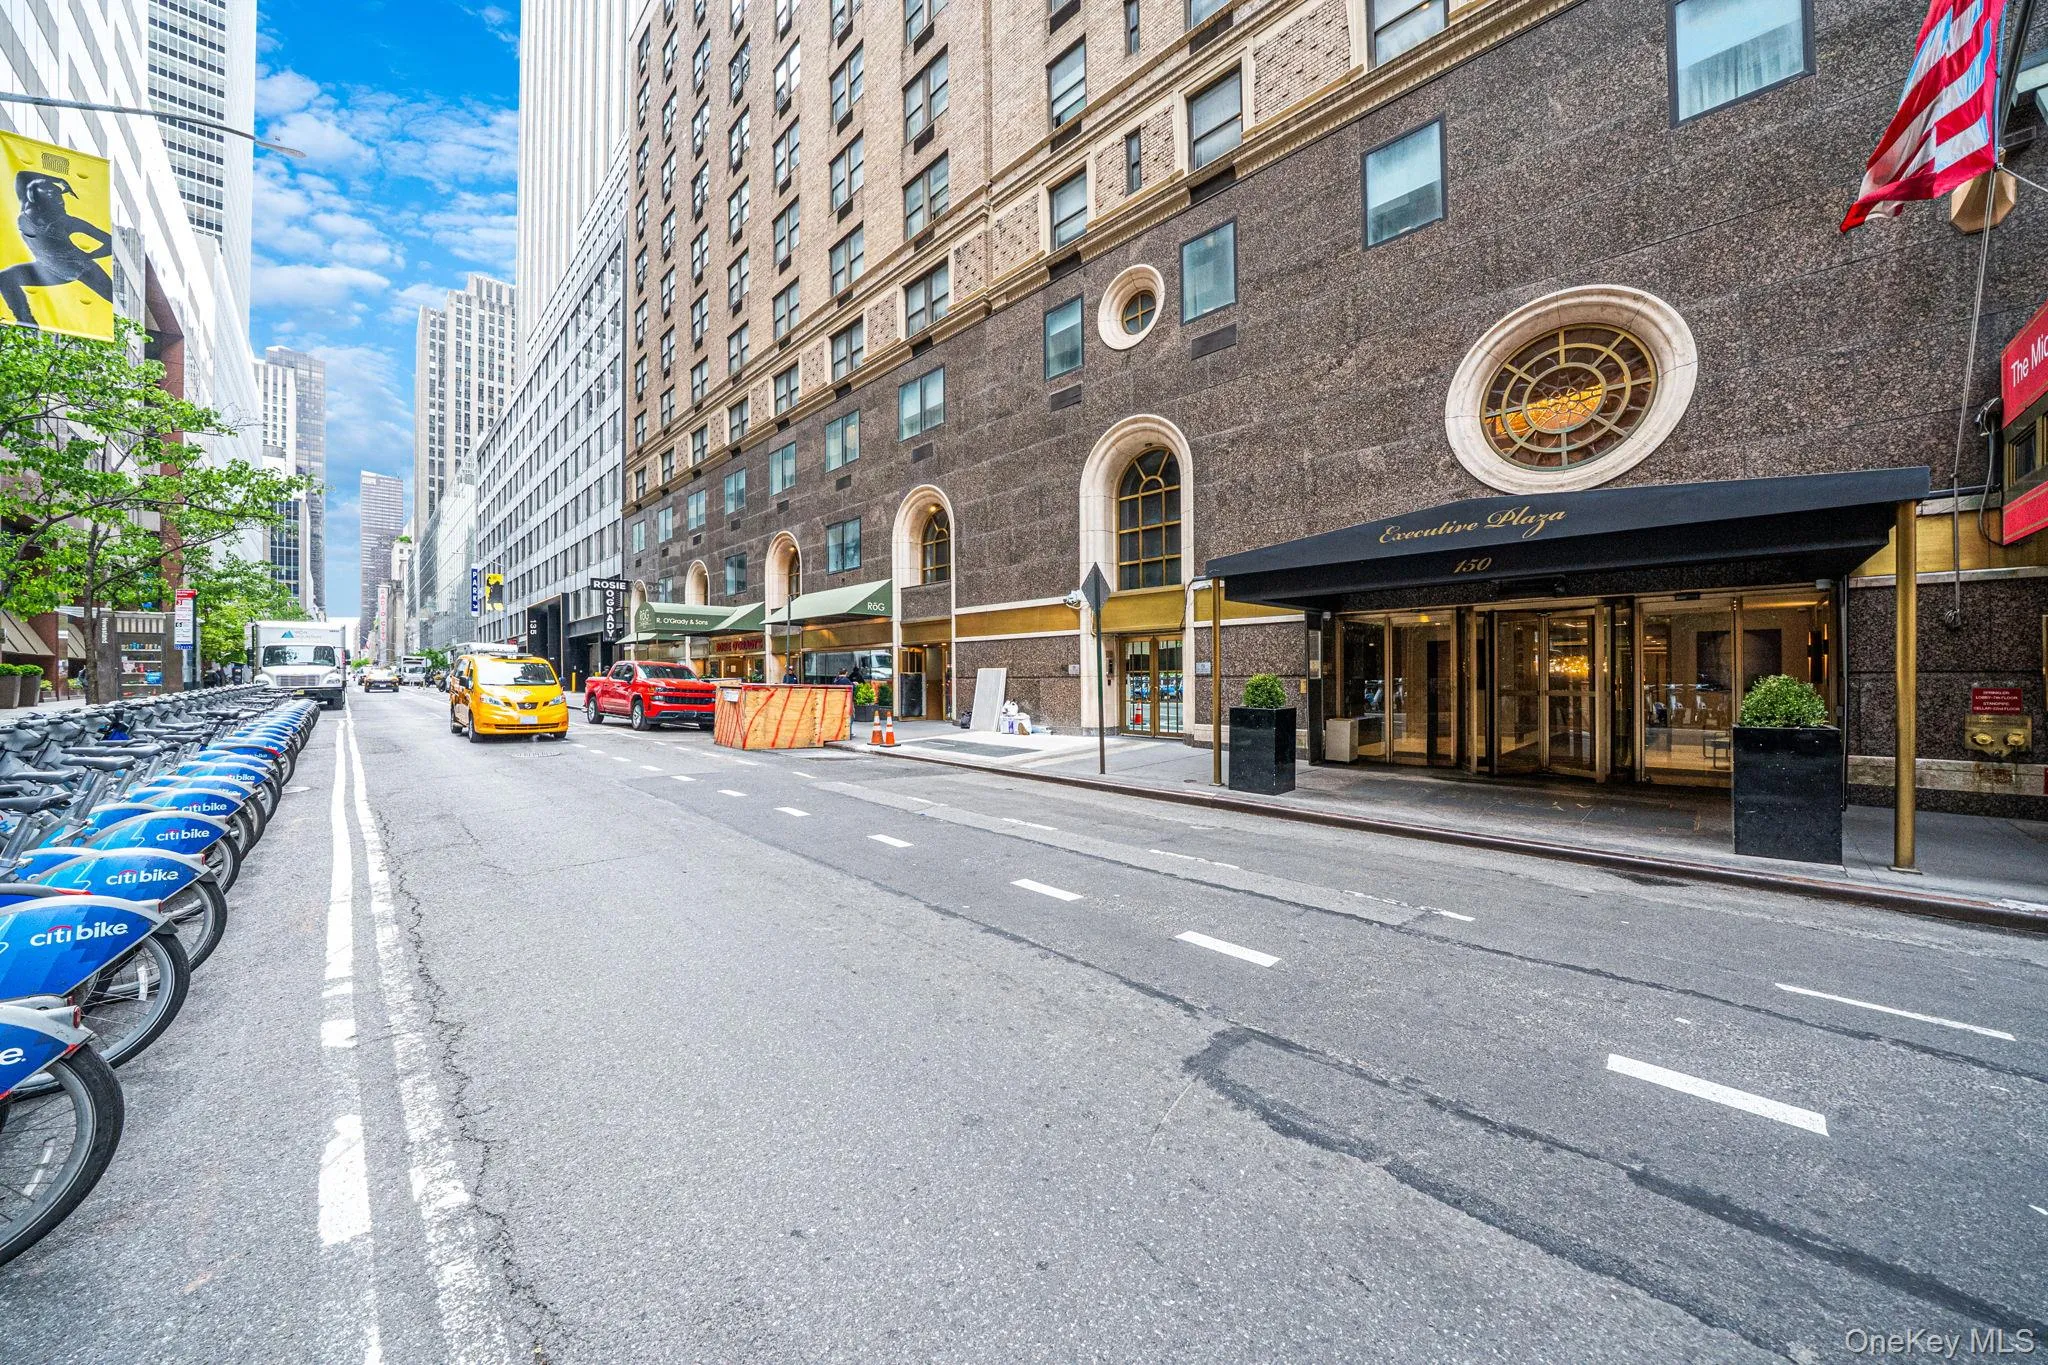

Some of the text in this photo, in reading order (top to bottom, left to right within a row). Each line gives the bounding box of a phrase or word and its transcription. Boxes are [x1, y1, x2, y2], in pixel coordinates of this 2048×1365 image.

[2011, 357, 2029, 388] The
[1379, 506, 1567, 544] Executive Plaza
[1453, 557, 1492, 574] 150
[593, 580, 626, 590] ROSIE
[529, 619, 537, 635] 135
[202, 802, 227, 812] bike
[156, 828, 210, 841] citi bike
[106, 868, 179, 885] citi bike
[30, 921, 128, 947] citi bike
